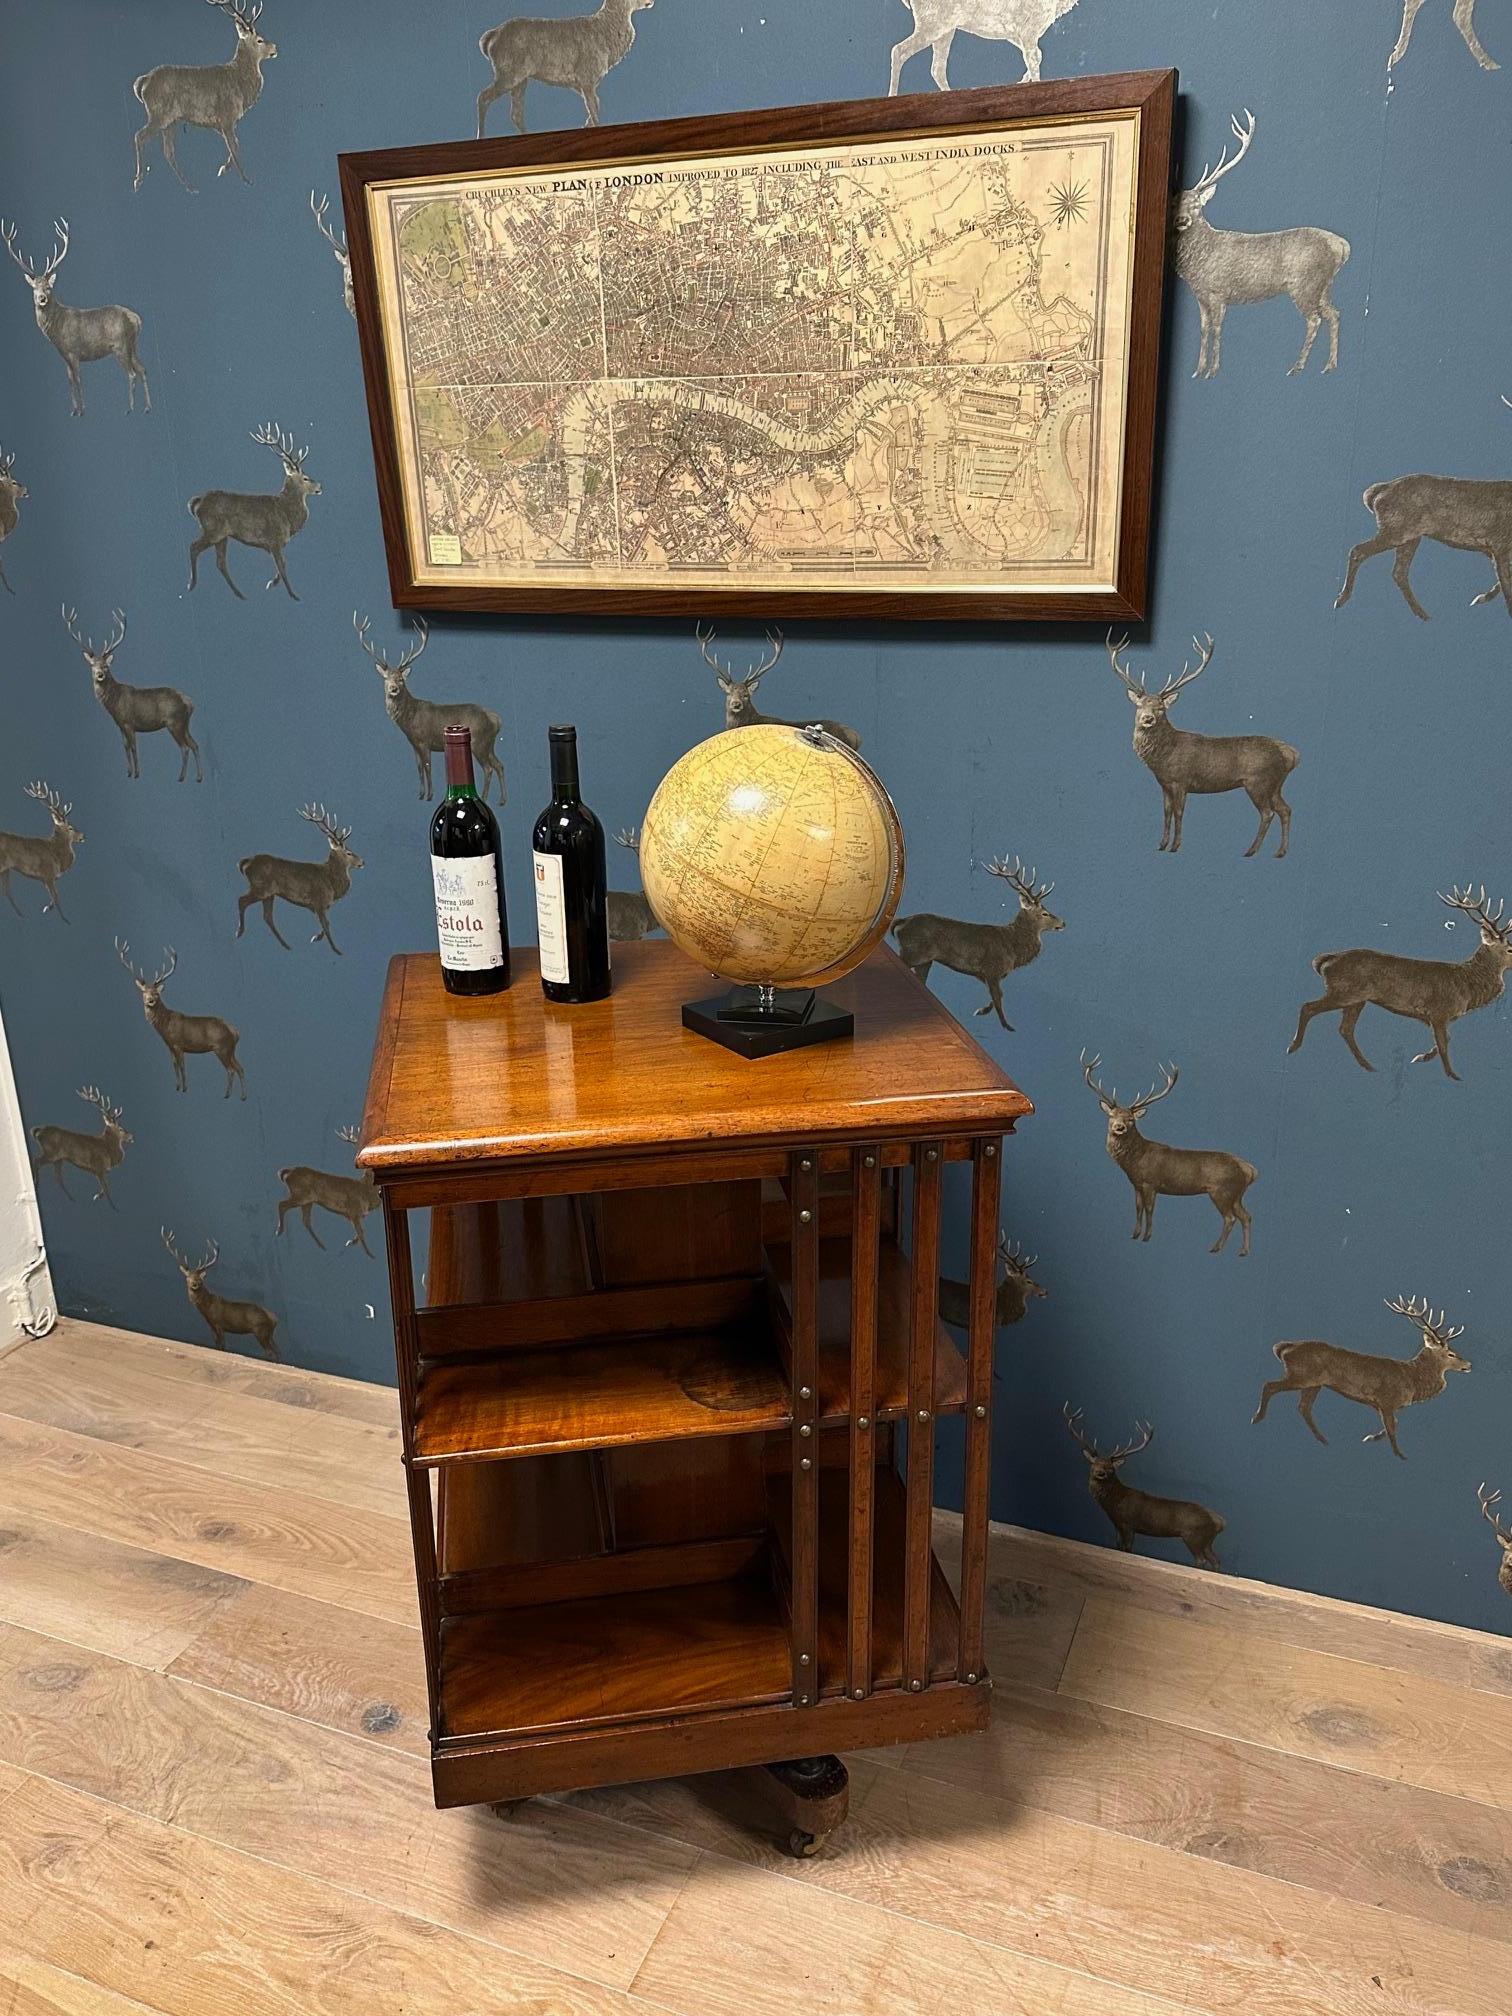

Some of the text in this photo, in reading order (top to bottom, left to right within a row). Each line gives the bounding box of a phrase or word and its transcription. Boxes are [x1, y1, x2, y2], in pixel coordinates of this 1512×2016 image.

[525, 184, 548, 195] NEW
[552, 178, 587, 192] PLAN
[605, 172, 664, 188] LONDON
[669, 170, 721, 183] IMPROVED
[723, 168, 738, 178] TO
[763, 160, 822, 175] INCLUDING
[825, 159, 843, 170] THE
[879, 155, 897, 165] AND
[900, 151, 932, 162] WEST
[935, 148, 970, 160] INDIA
